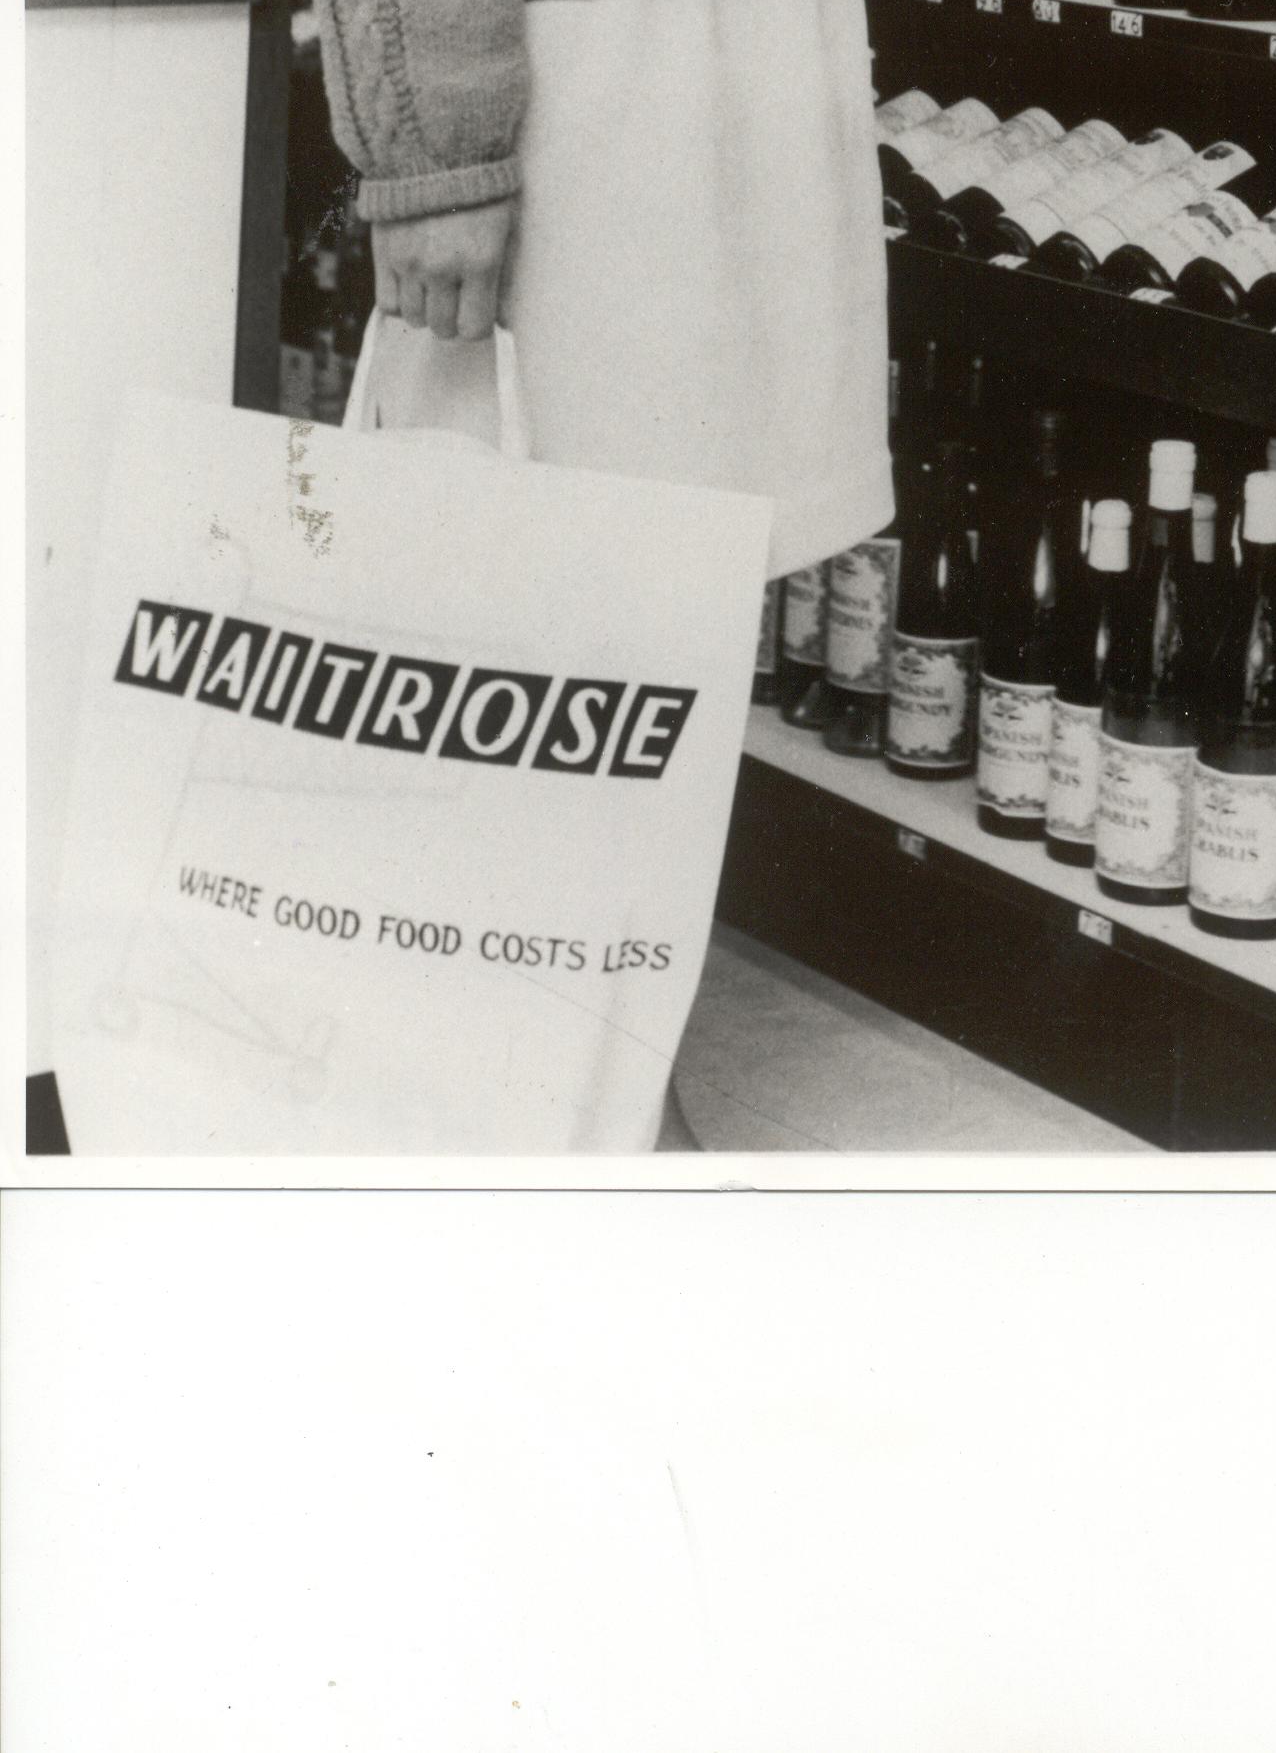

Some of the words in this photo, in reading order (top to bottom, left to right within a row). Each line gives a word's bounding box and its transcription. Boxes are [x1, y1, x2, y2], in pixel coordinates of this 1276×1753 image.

[126, 608, 684, 769] WAITROSE
[179, 866, 263, 919] WHERE
[275, 895, 360, 940] GOOD
[378, 916, 461, 956] FOOD
[480, 931, 587, 972] COSTS
[601, 940, 673, 973] LESS
